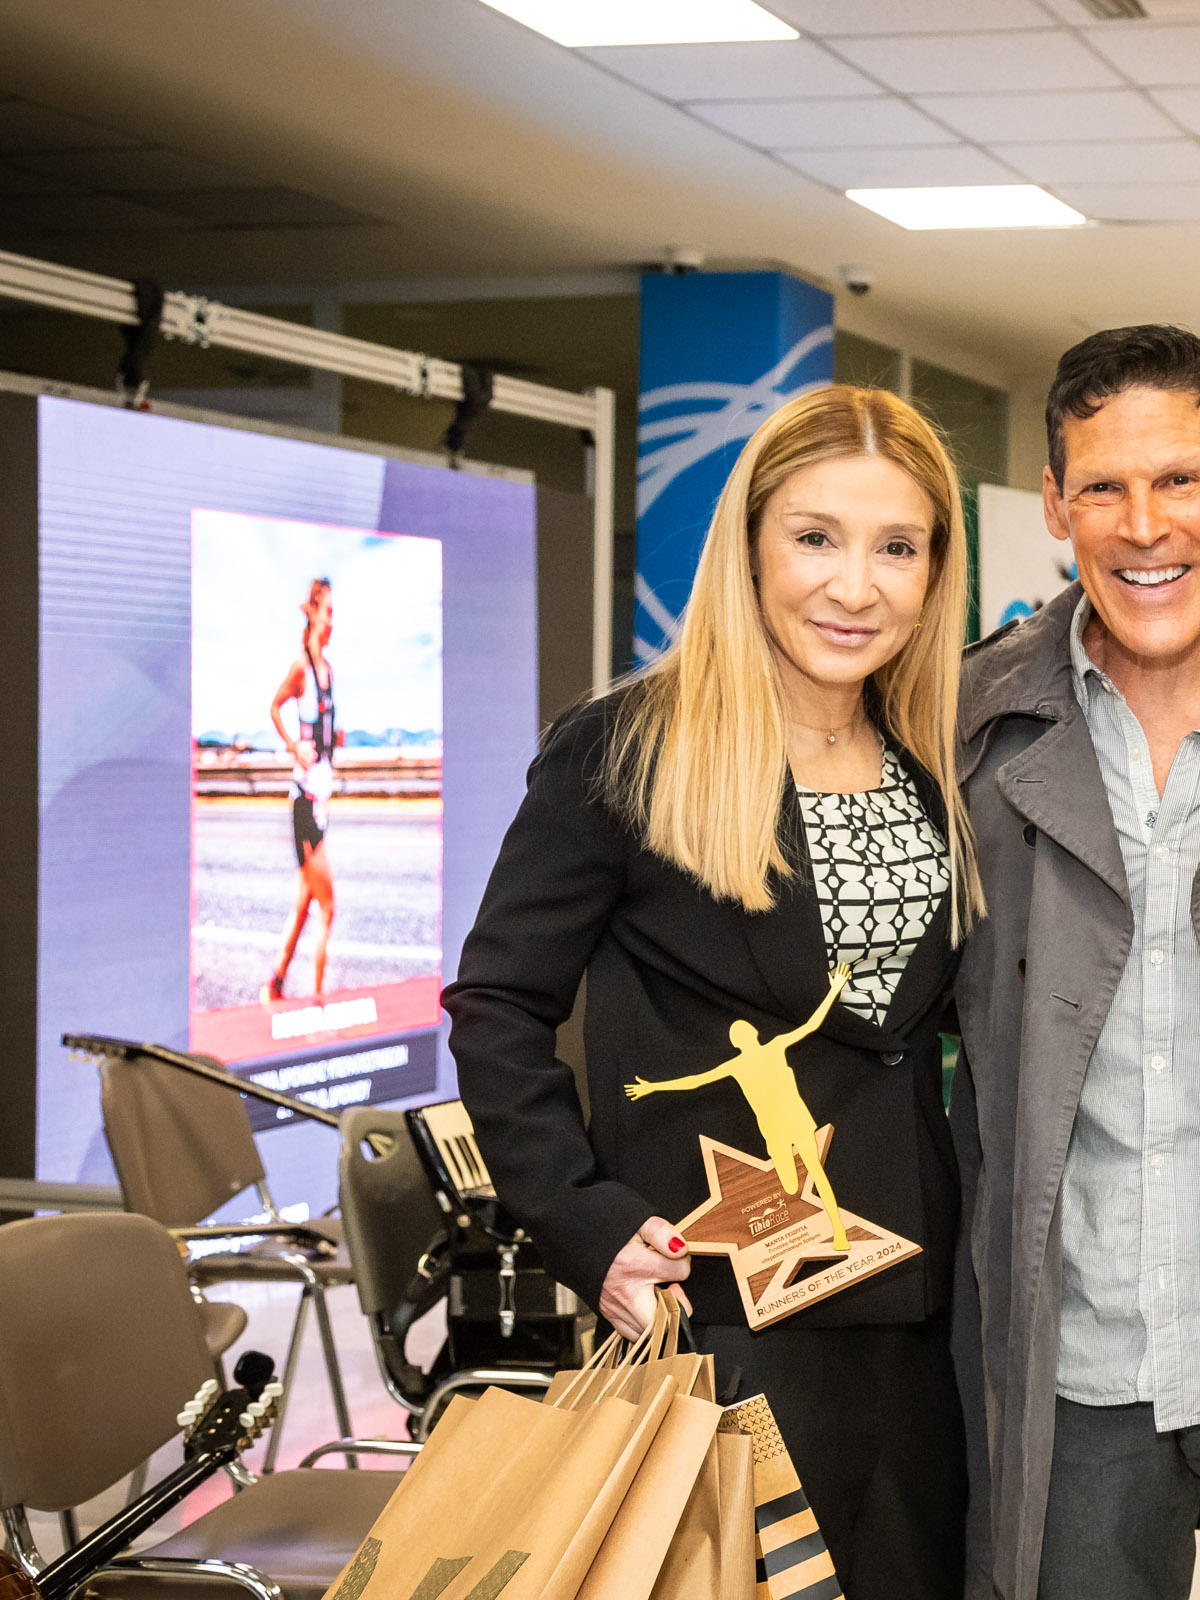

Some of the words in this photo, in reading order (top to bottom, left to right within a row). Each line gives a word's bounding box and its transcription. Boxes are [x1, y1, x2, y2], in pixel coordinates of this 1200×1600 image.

[741, 1195, 773, 1215] POWERED
[773, 1191, 782, 1200] BY
[749, 1210, 789, 1235] TihioRace
[765, 1236, 785, 1248] ΜΑΝΤΑ
[785, 1225, 808, 1240] ΓΕΩΡΓΙΑ
[756, 1288, 806, 1318] RUNNERS
[807, 1280, 822, 1292] OF
[823, 1269, 845, 1284] THE
[845, 1255, 876, 1273] YEAR
[876, 1242, 902, 1260] 2024
